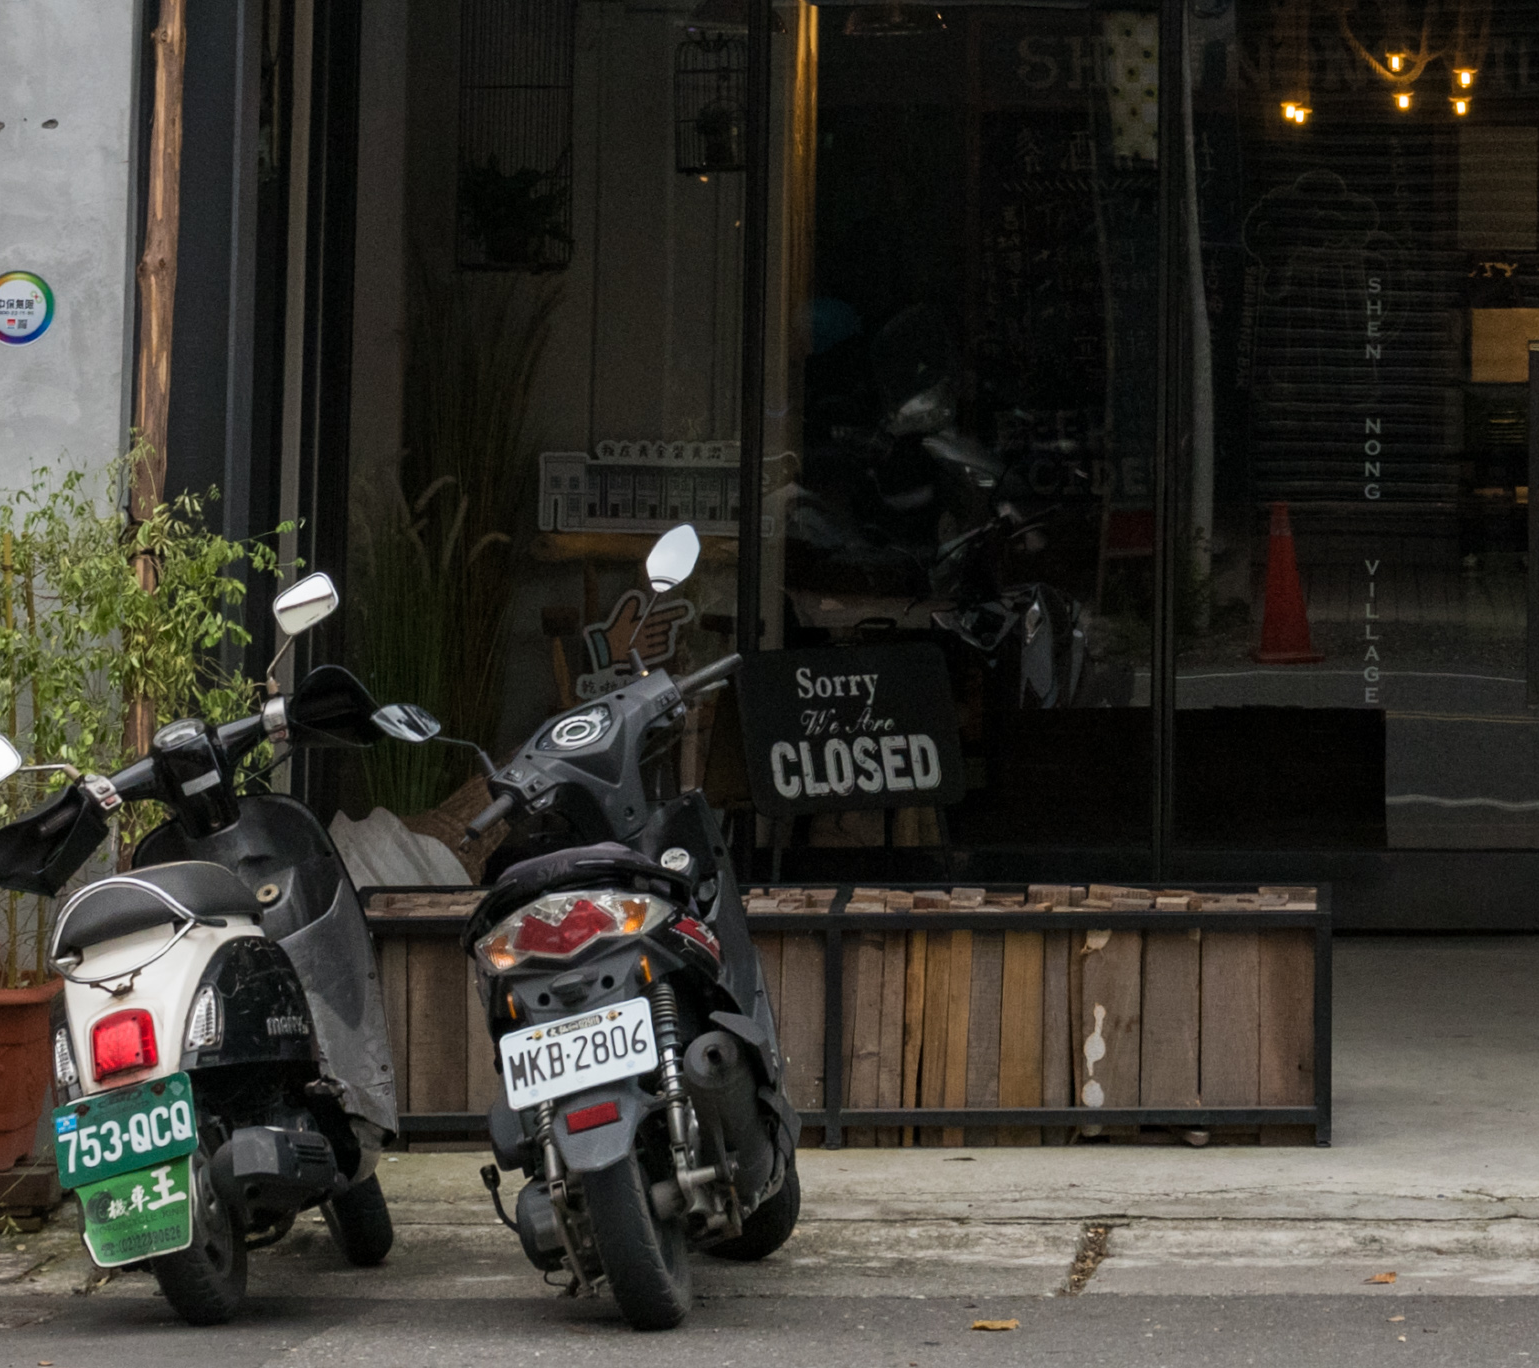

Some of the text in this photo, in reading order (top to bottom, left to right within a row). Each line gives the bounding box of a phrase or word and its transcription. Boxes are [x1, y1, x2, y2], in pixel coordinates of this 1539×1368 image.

[1363, 276, 1383, 705] SHEN NONG VILLAGE
[795, 667, 879, 705] Sorry
[800, 706, 895, 736] We Are
[770, 733, 942, 799] CLOSED
[107, 1164, 188, 1220] 機車王
